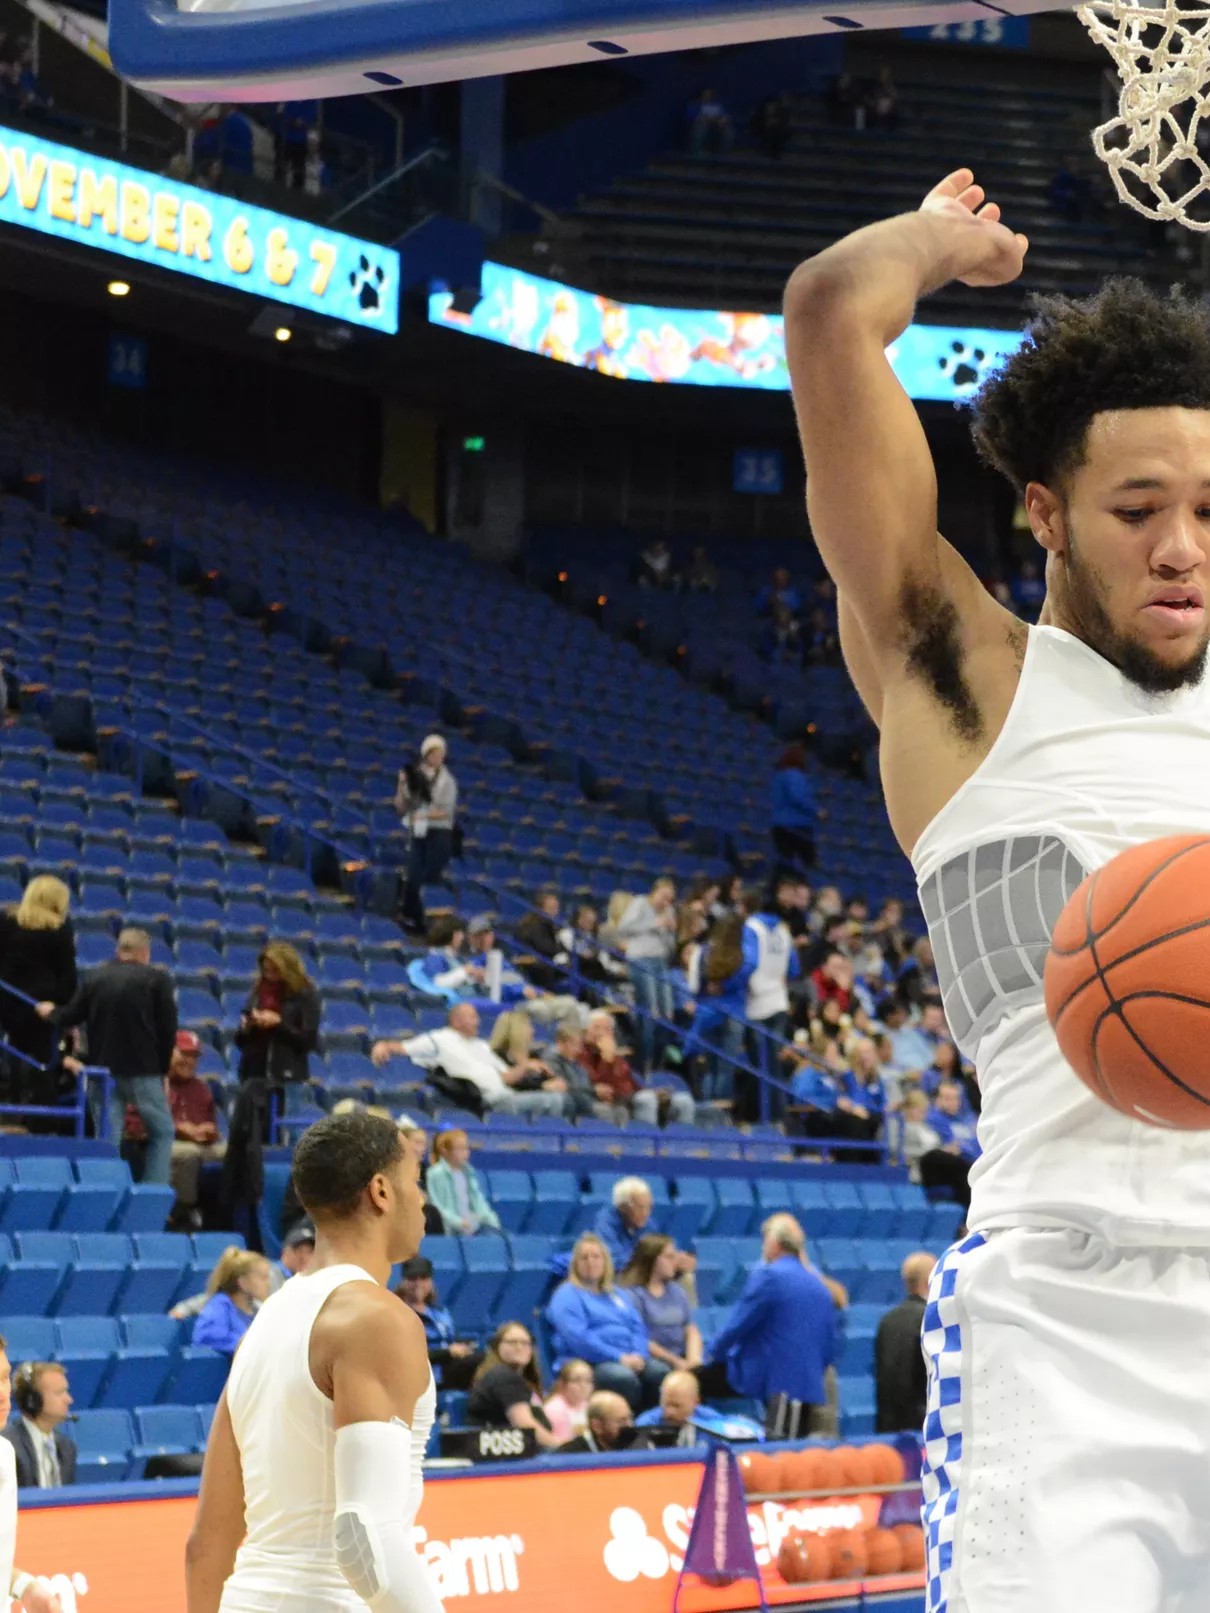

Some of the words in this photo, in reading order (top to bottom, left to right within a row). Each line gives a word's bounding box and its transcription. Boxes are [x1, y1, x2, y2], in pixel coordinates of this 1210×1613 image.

[223, 215, 254, 274] 6
[265, 228, 298, 286] &
[309, 240, 337, 297] 7
[479, 1427, 525, 1456] POSS
